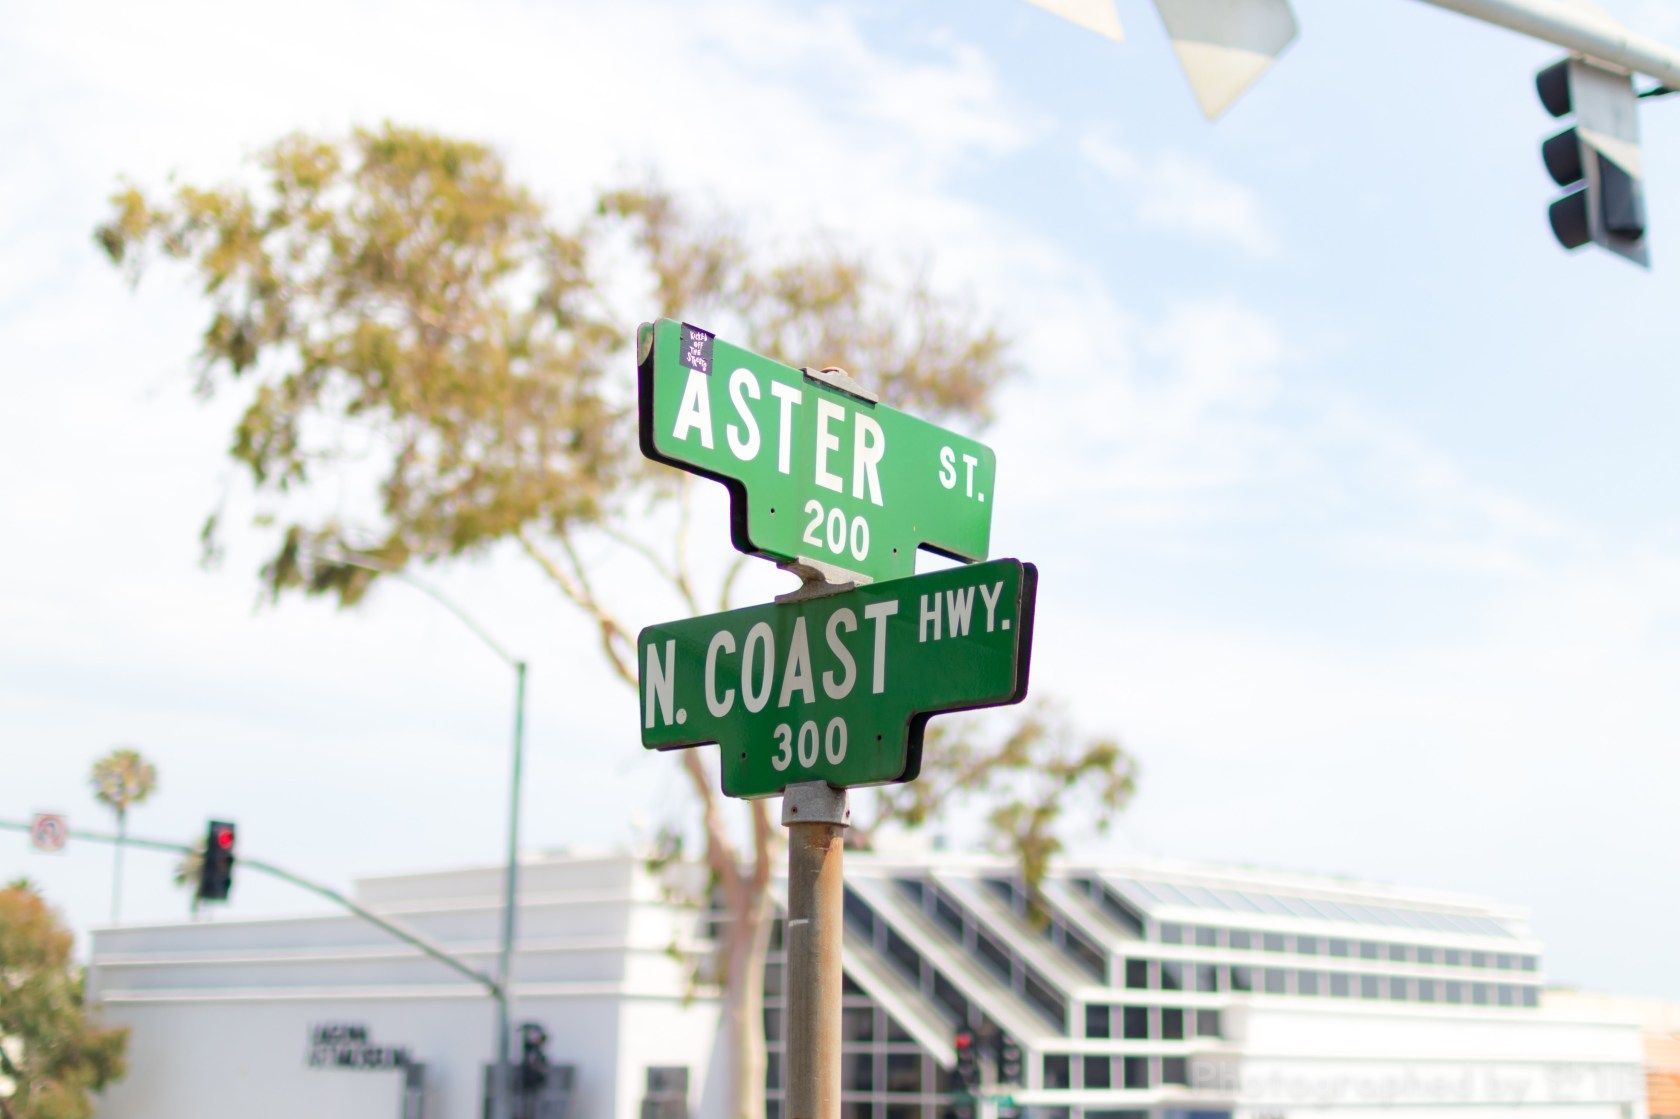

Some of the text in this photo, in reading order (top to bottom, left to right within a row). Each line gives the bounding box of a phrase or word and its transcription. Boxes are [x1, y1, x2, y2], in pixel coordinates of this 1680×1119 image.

[672, 367, 985, 507] ASTER ST.
[802, 499, 870, 562] 200
[645, 581, 1011, 729] N. COAST HWY.
[771, 716, 848, 772] 300
